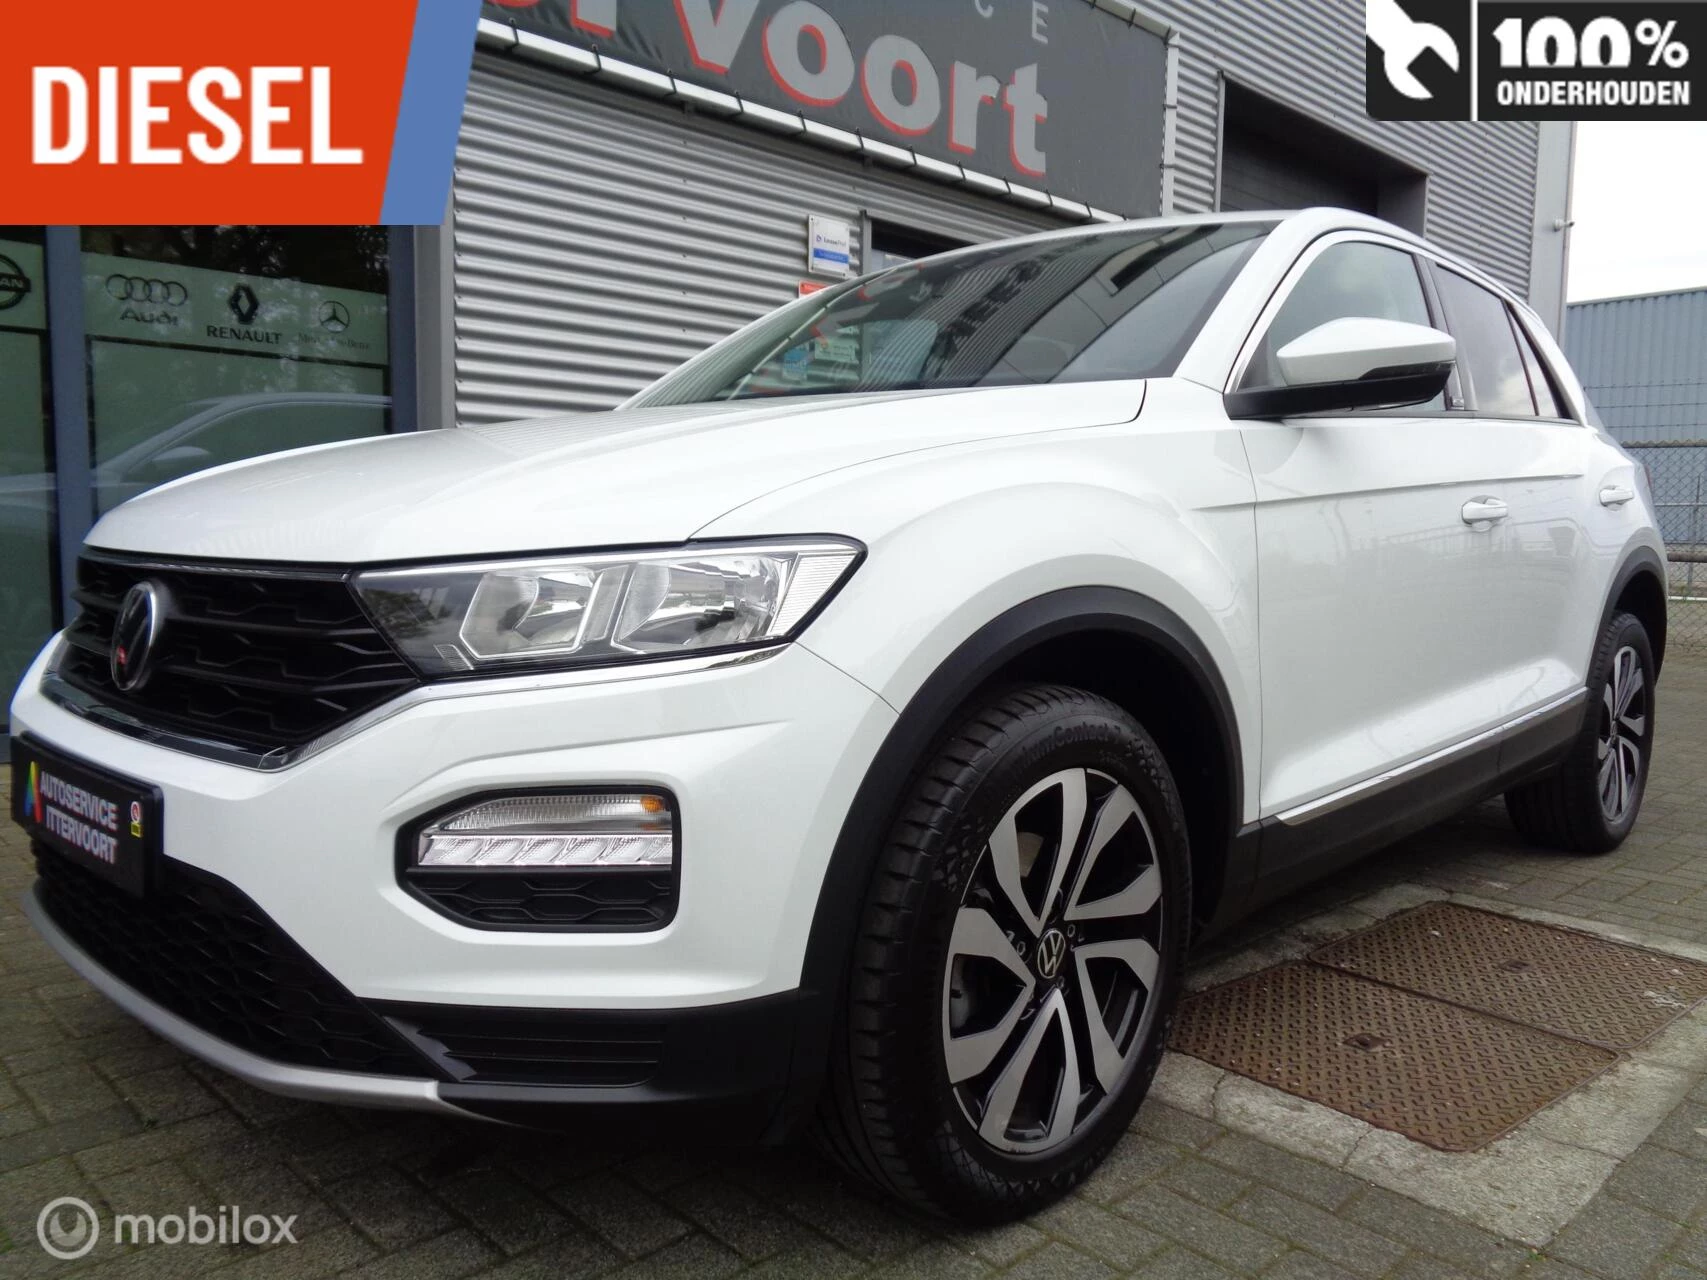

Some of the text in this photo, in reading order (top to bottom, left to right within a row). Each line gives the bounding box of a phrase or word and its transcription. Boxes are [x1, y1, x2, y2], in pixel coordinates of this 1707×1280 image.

[119, 307, 179, 326] Audi
[206, 325, 282, 345] RENAULT
[40, 771, 118, 831] AUTOSERVICE
[46, 805, 118, 864] ITTERVOORT
